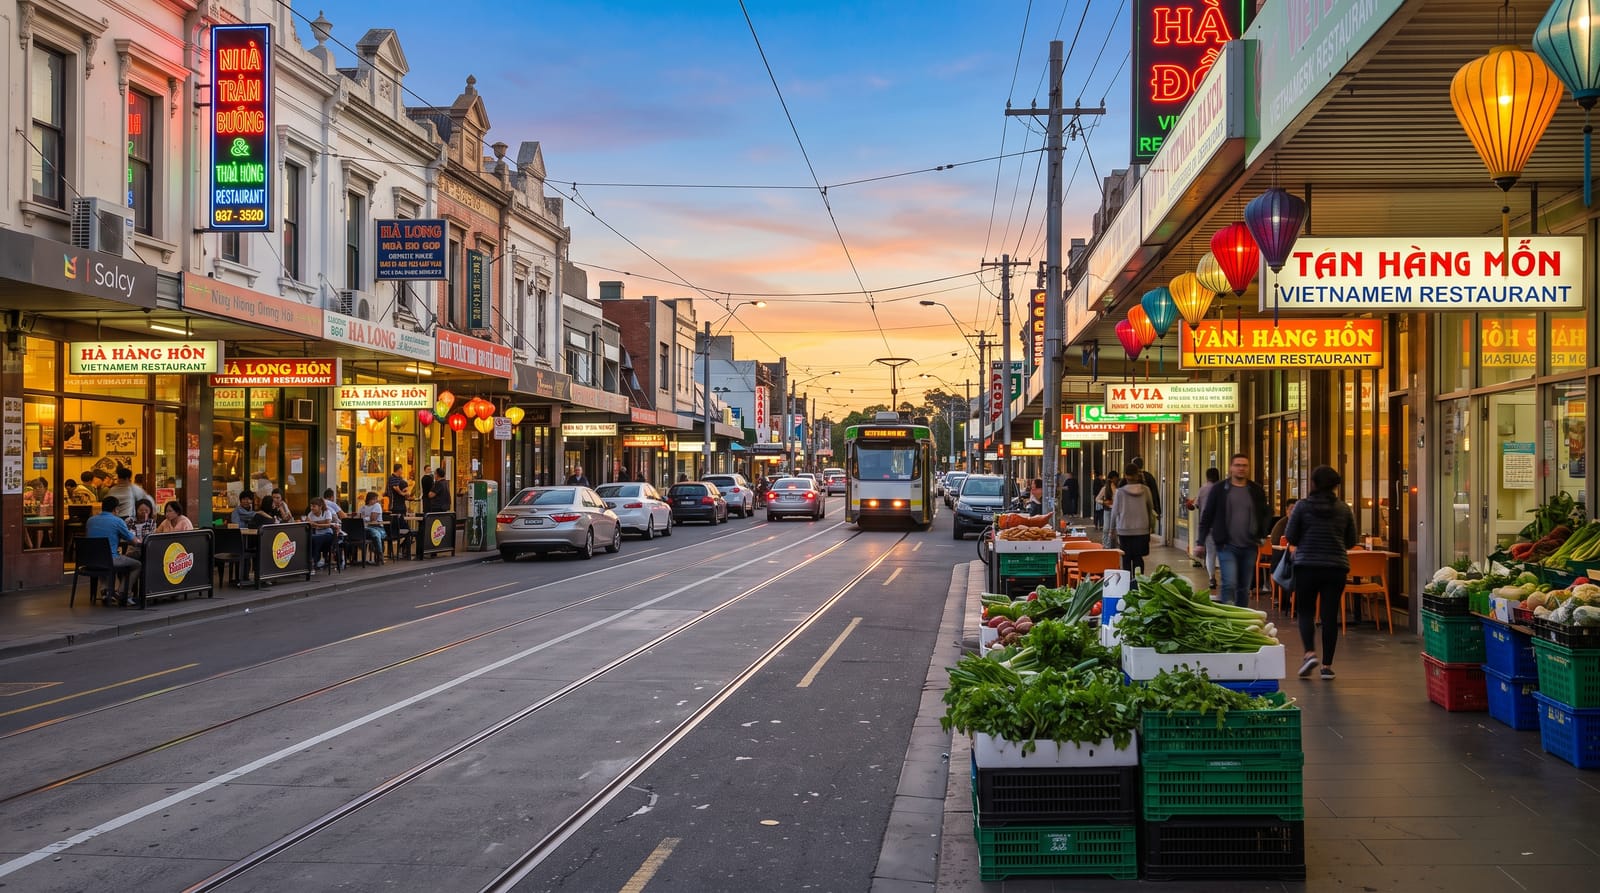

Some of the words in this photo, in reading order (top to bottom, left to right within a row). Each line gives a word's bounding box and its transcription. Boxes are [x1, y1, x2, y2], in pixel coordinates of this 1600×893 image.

[1158, 115, 1182, 131] VI
[231, 138, 250, 157] &
[239, 209, 264, 221] 3520
[404, 225, 443, 239] LONG
[1379, 245, 1471, 280] HÀNG
[95, 262, 136, 298] Salcy
[1279, 286, 1412, 303] VIETNAMEM
[1419, 286, 1572, 303] RESTAURANT
[348, 320, 366, 343] HA
[367, 325, 397, 350] LONG
[81, 344, 107, 360] HÀ
[112, 344, 162, 360] HÀNG
[1194, 354, 1275, 365] VIETNAMEM
[1280, 353, 1372, 364] RESTAURANT
[81, 363, 138, 372] VIETNAMEM
[142, 362, 206, 371] RESTAURANT
[246, 363, 292, 375] LONG
[273, 376, 332, 384] RESTAURANT
[1130, 388, 1164, 400] VIA
[383, 399, 428, 407] RESTAURANT
